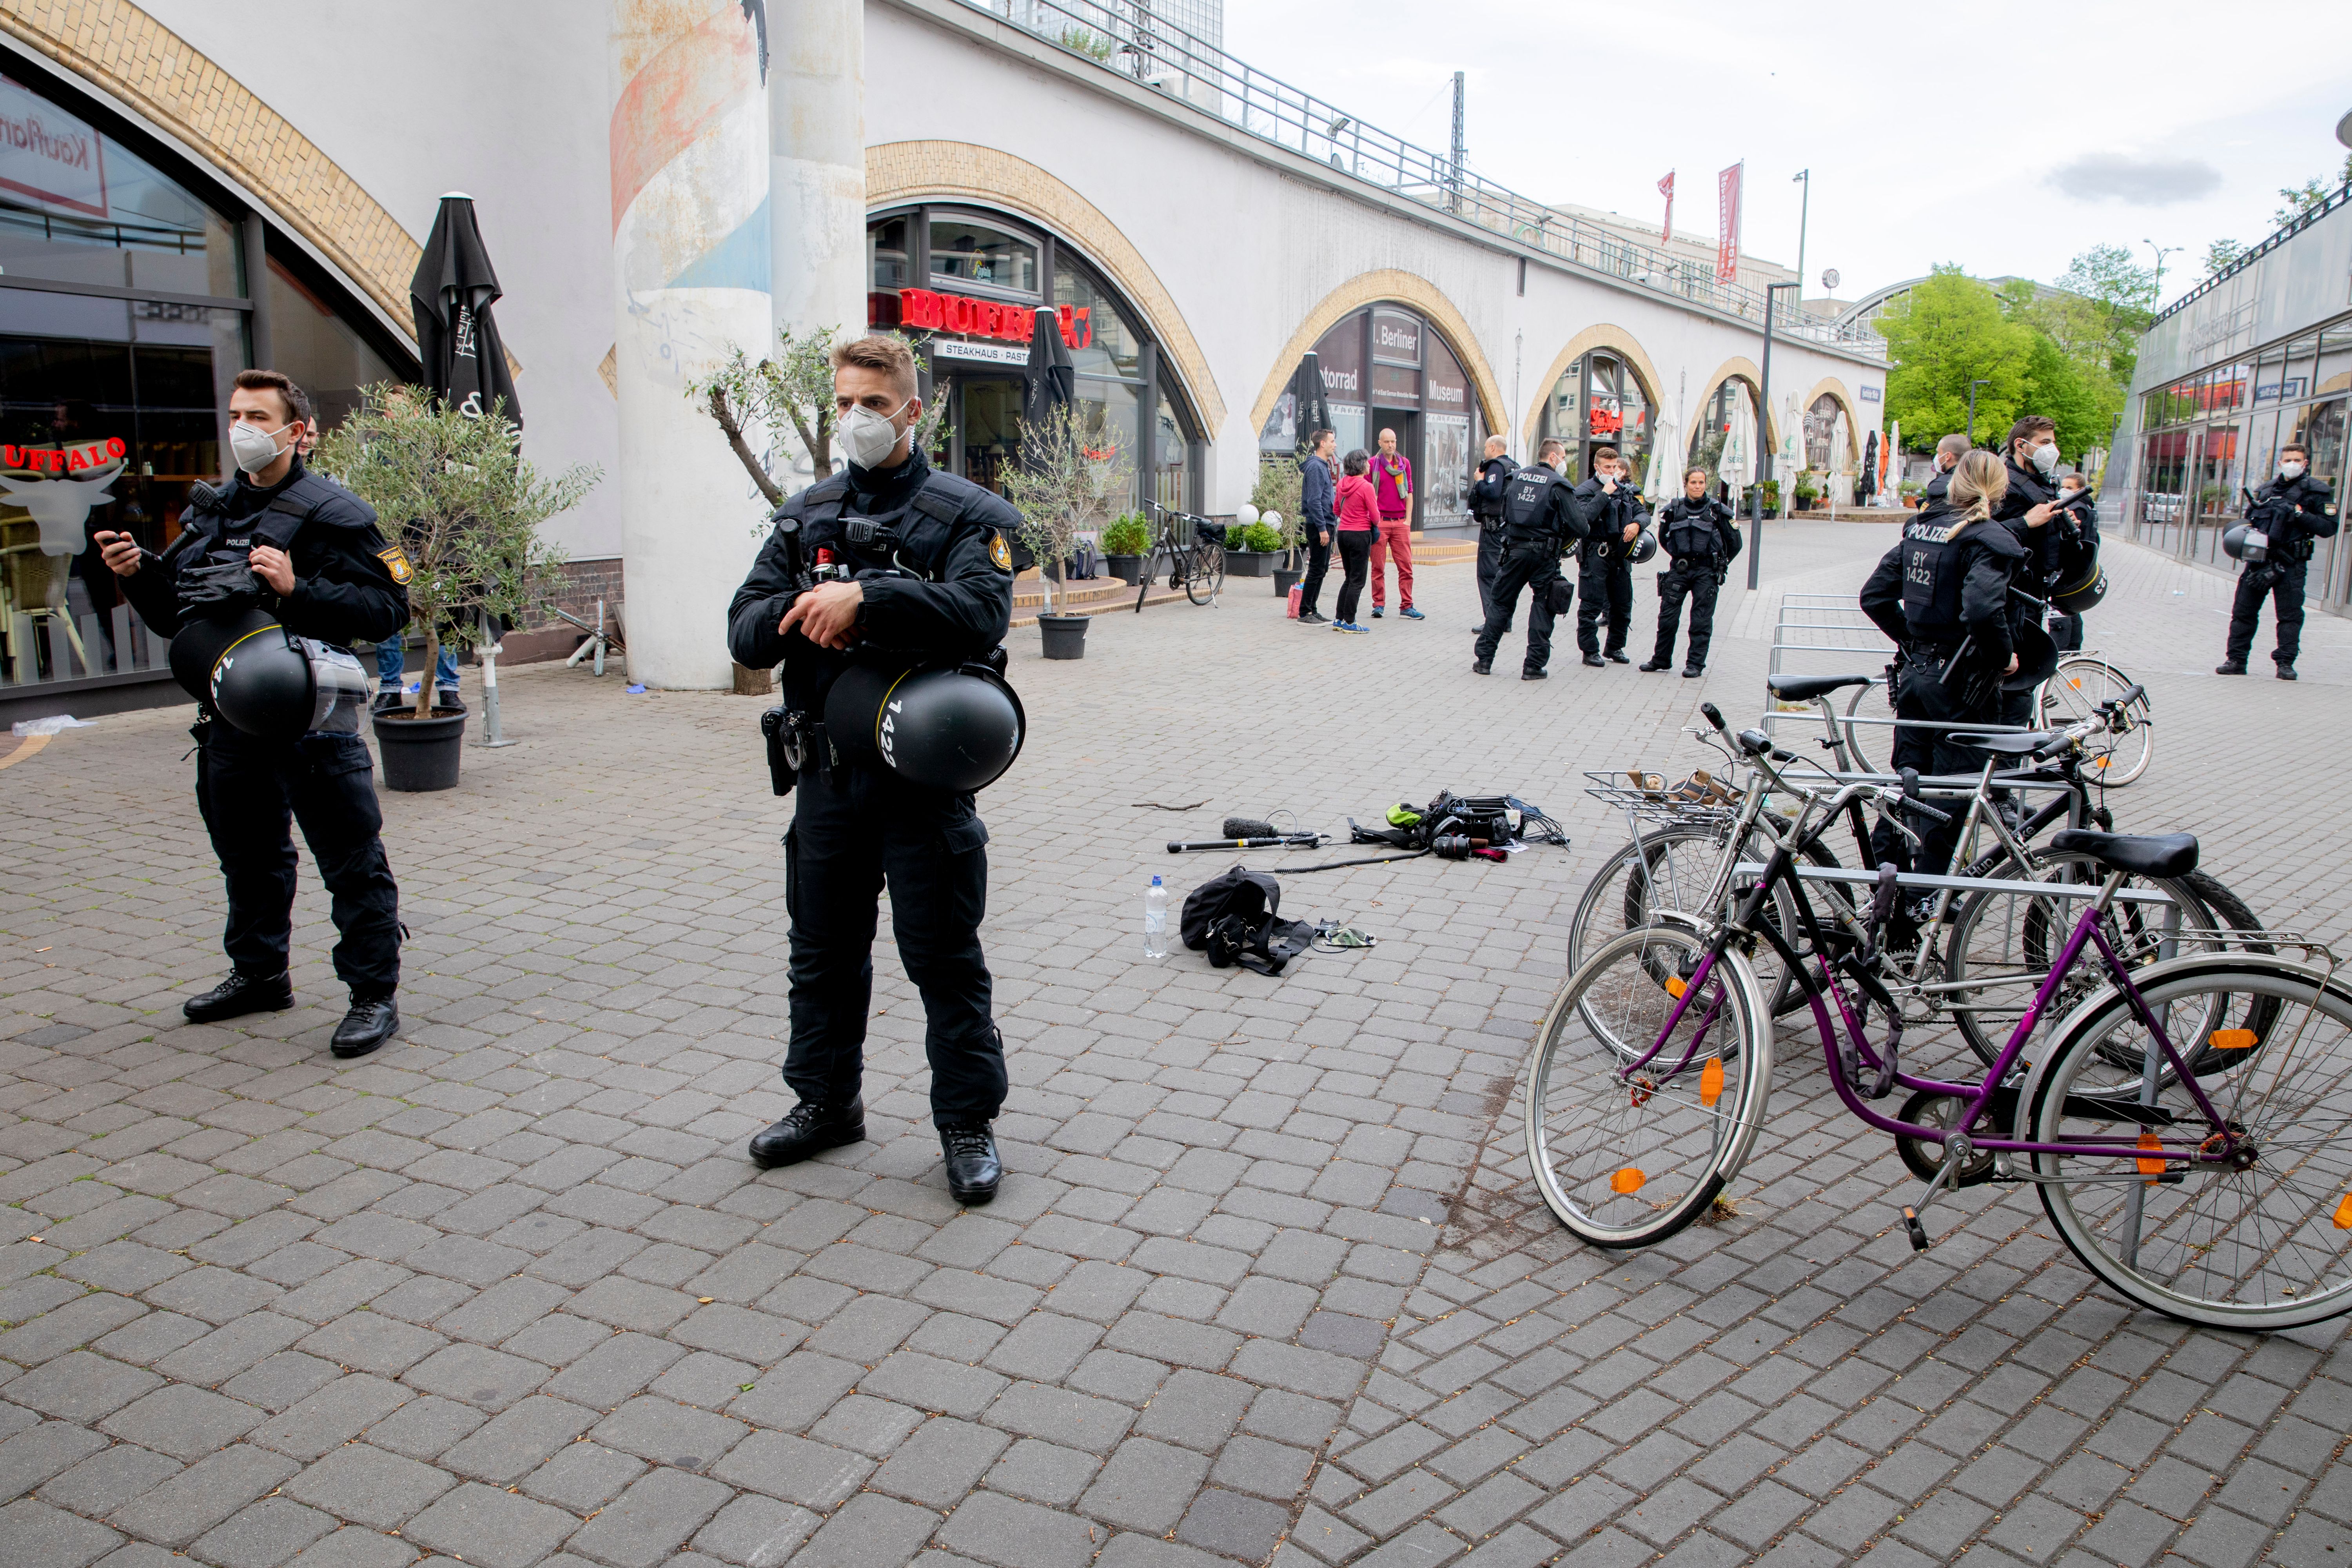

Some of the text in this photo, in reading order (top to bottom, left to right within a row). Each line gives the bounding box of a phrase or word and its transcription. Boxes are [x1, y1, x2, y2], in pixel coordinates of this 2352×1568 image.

[1381, 325, 1417, 350] Berliner
[946, 345, 998, 358] STEAKHAUS
[1429, 379, 1463, 403] Museum
[3, 437, 126, 472] UFFALO
[1517, 472, 1548, 484] POLIZEI
[1517, 493, 1535, 502] 1422
[1523, 486, 1534, 494] BY
[382, 550, 400, 561] POLIZEI
[1632, 539, 1644, 557] 1423
[1912, 551, 1928, 567] BY
[1906, 566, 1931, 586] 1422
[211, 657, 234, 711] 142
[881, 700, 902, 768] 1422
[1967, 858, 1994, 877] Hup
